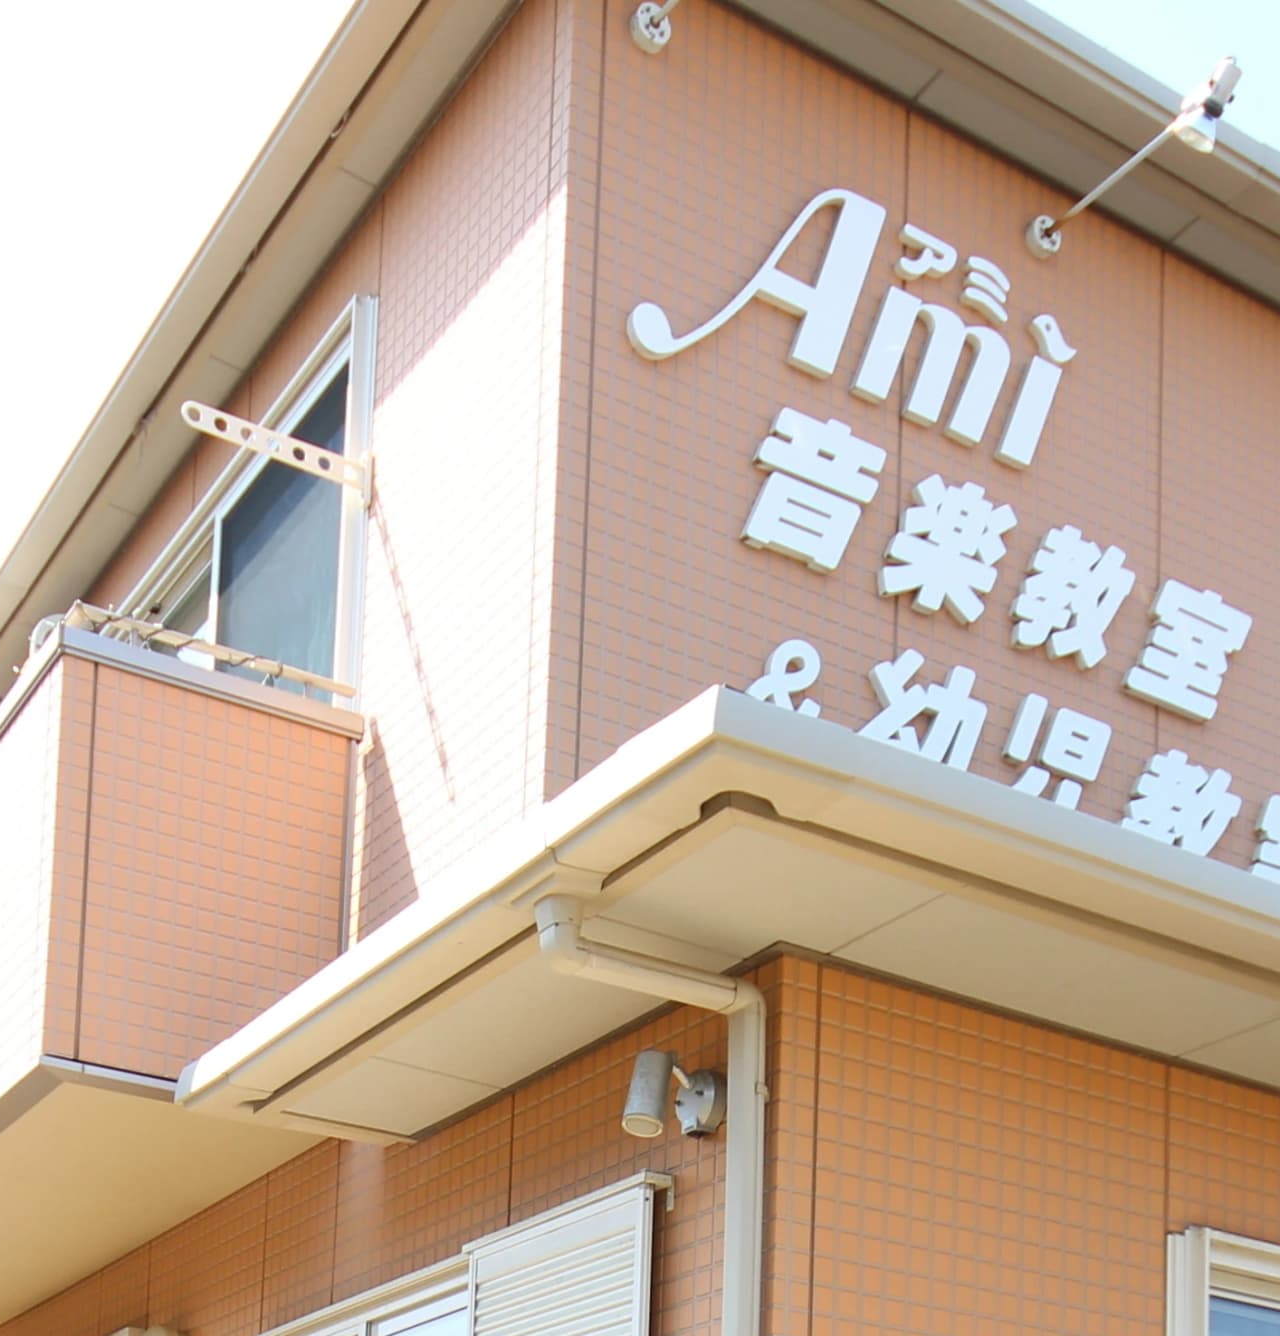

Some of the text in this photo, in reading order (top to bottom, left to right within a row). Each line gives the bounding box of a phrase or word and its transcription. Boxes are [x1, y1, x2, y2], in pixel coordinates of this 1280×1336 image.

[894, 223, 1012, 325] アミ
[739, 406, 1253, 723] 音楽教室
